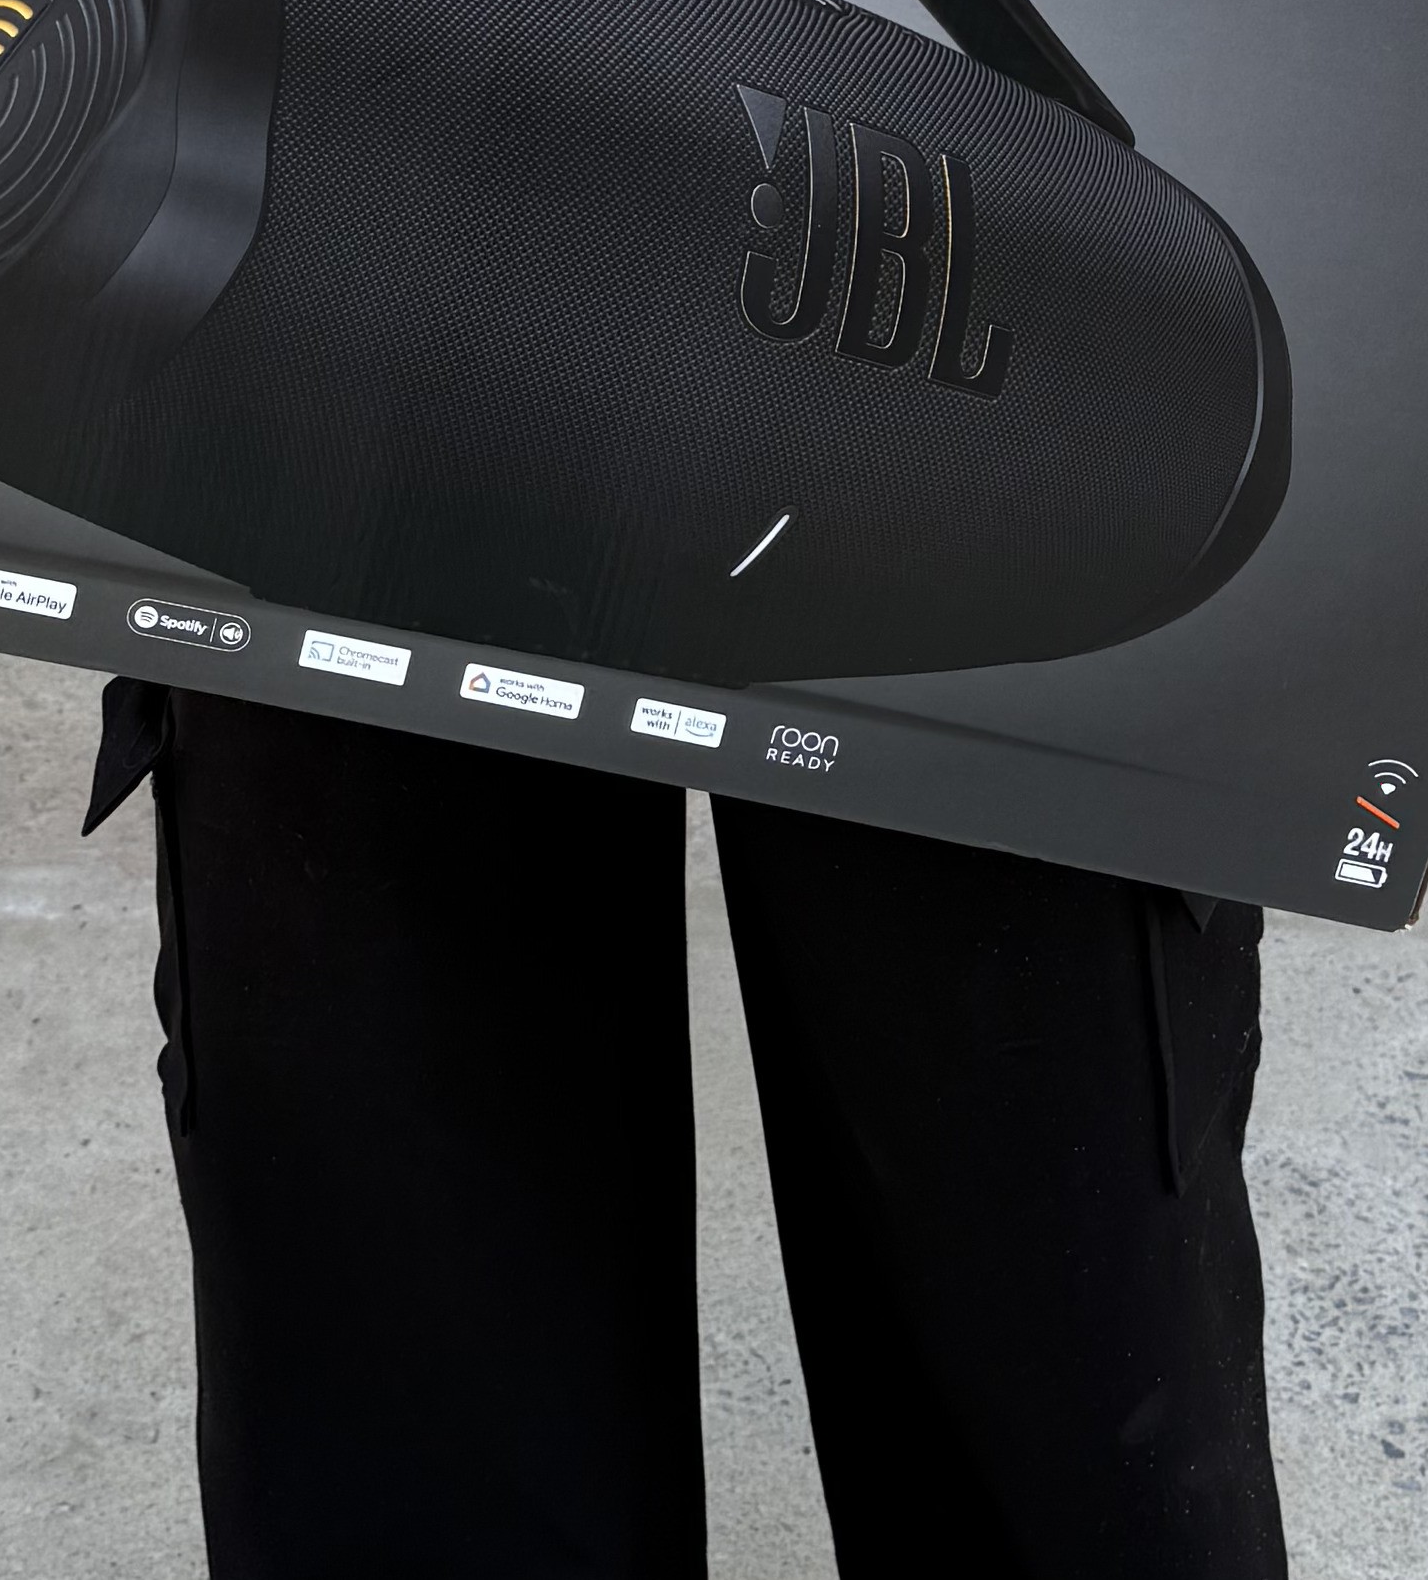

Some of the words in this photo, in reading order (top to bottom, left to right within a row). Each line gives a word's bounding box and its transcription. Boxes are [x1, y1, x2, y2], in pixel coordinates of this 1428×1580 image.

[736, 106, 1015, 399] JBL
[15, 591, 67, 614] AirPlay
[159, 614, 209, 636] Spotify
[339, 646, 399, 666] Chromecast
[495, 686, 539, 704] Google
[685, 714, 717, 732] alexa
[769, 725, 839, 757] roon
[765, 747, 835, 773] READY
[1343, 827, 1394, 863] 24H
